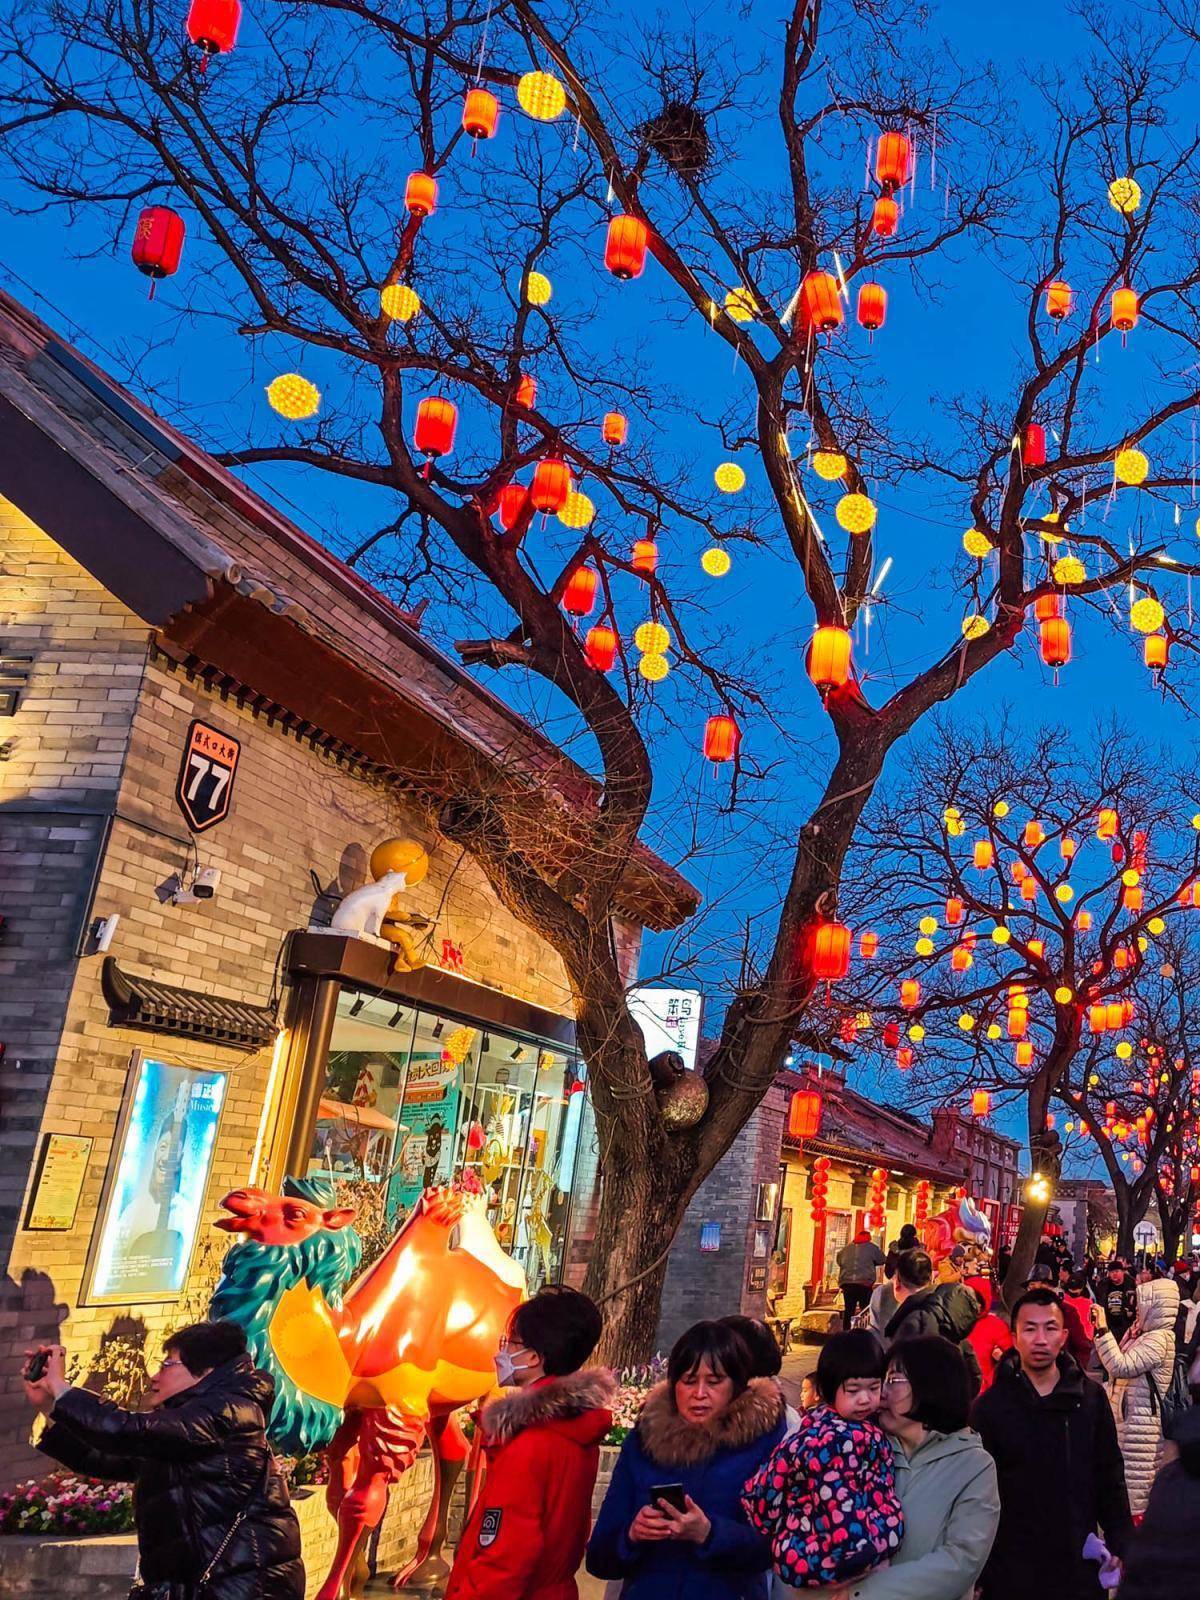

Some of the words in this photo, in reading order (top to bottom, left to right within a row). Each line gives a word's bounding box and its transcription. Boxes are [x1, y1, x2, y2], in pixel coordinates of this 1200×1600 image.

[194, 730, 236, 762] 模式口大街
[187, 753, 231, 812] 77
